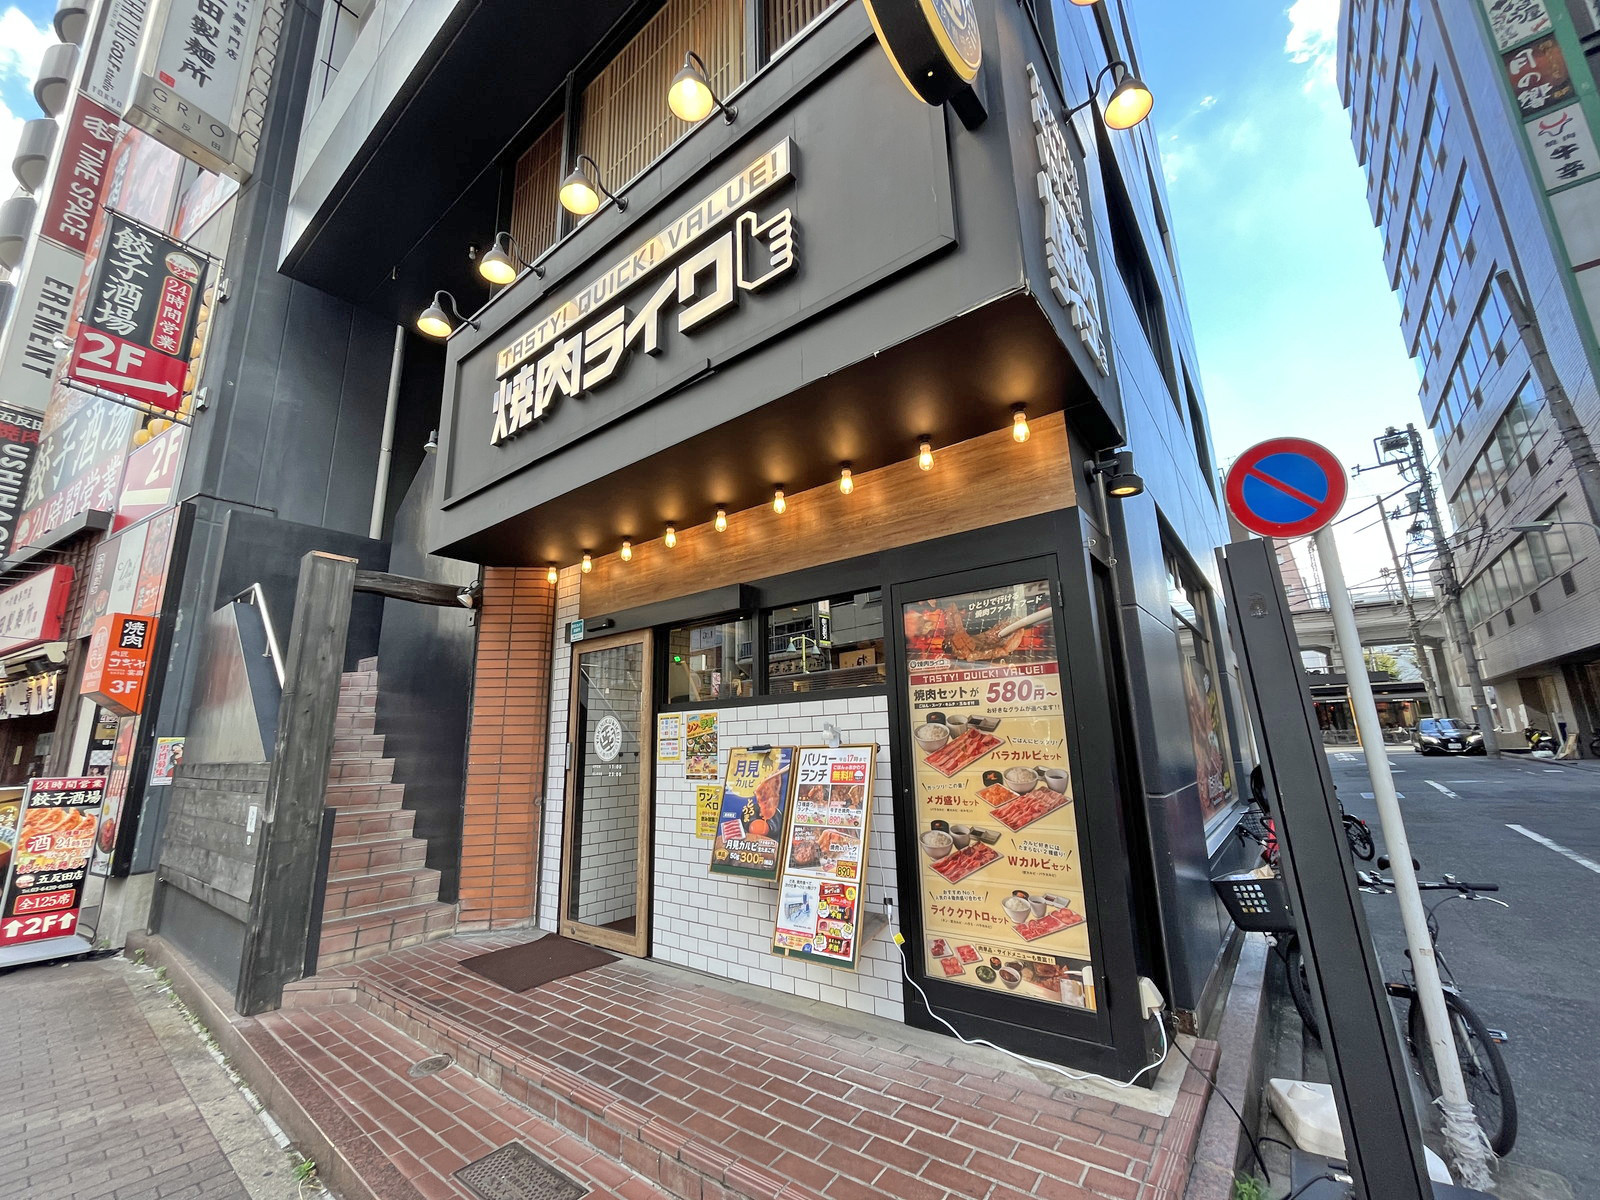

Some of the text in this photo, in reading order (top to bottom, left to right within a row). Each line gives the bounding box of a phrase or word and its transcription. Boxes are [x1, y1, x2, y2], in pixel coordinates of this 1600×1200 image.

[107, 40, 126, 72] GOLF
[153, 87, 225, 138] GRIO
[59, 142, 108, 241] TIME SPACE
[502, 151, 778, 368] TASTY! QUICK! VALUE!
[94, 226, 153, 336] 餃子酒場
[156, 279, 189, 352] 24時間営業
[490, 231, 735, 447] 焼肉ライク
[79, 332, 146, 374] 2F
[145, 428, 182, 486] 2F
[968, 592, 1019, 611] ひとりで行ける
[975, 595, 1043, 619] 焼肉ファストフード
[121, 620, 145, 648] 焼肉
[922, 664, 1044, 684] TASTY! QUICK! VALUE!
[109, 679, 138, 694] 3F
[733, 760, 760, 778] 月見
[802, 753, 837, 766] バリュー
[35, 779, 104, 791] 24時間営業
[735, 778, 756, 789] カルビ
[801, 769, 828, 782] ランチ
[31, 790, 102, 806] 餃子酒場
[27, 834, 52, 853] 酒
[725, 840, 759, 852] 月見カルビ
[1007, 855, 1072, 872] Wカルビセット
[36, 870, 85, 885] 五反田店
[19, 894, 71, 910] 全125席
[23, 914, 59, 936] 2F
